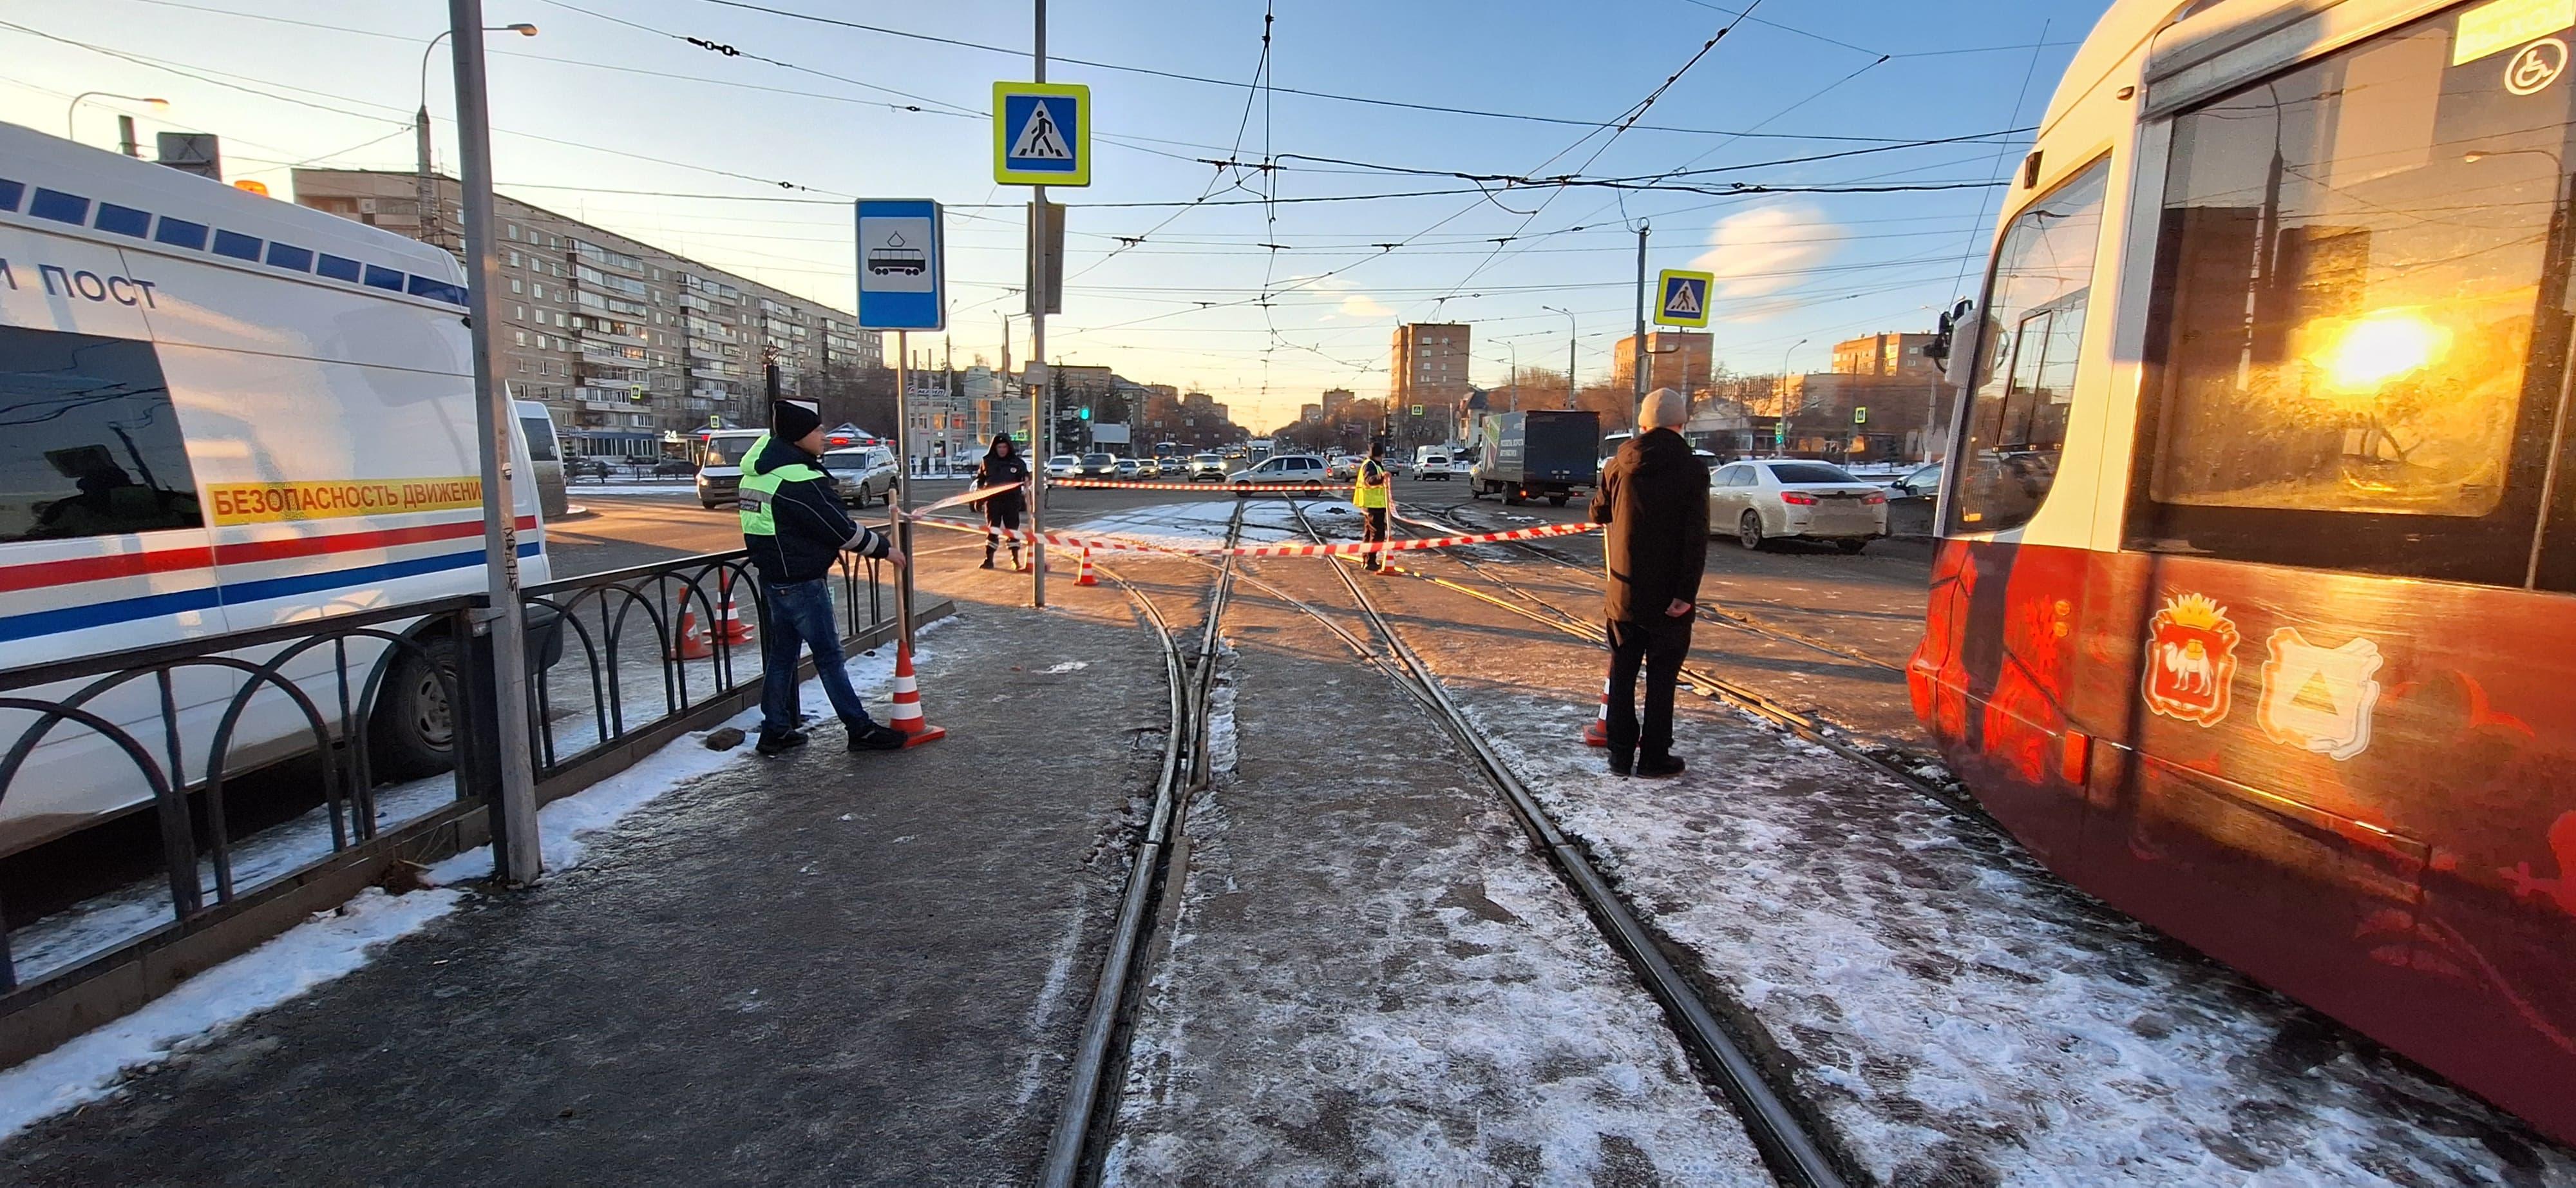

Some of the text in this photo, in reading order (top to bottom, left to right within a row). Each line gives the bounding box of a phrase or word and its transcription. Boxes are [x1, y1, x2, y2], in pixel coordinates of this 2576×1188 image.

[37, 263, 156, 309] ПОСТ
[213, 481, 482, 515] БЕЗОПАСНОСТЬ ДВИЖЕНИ
